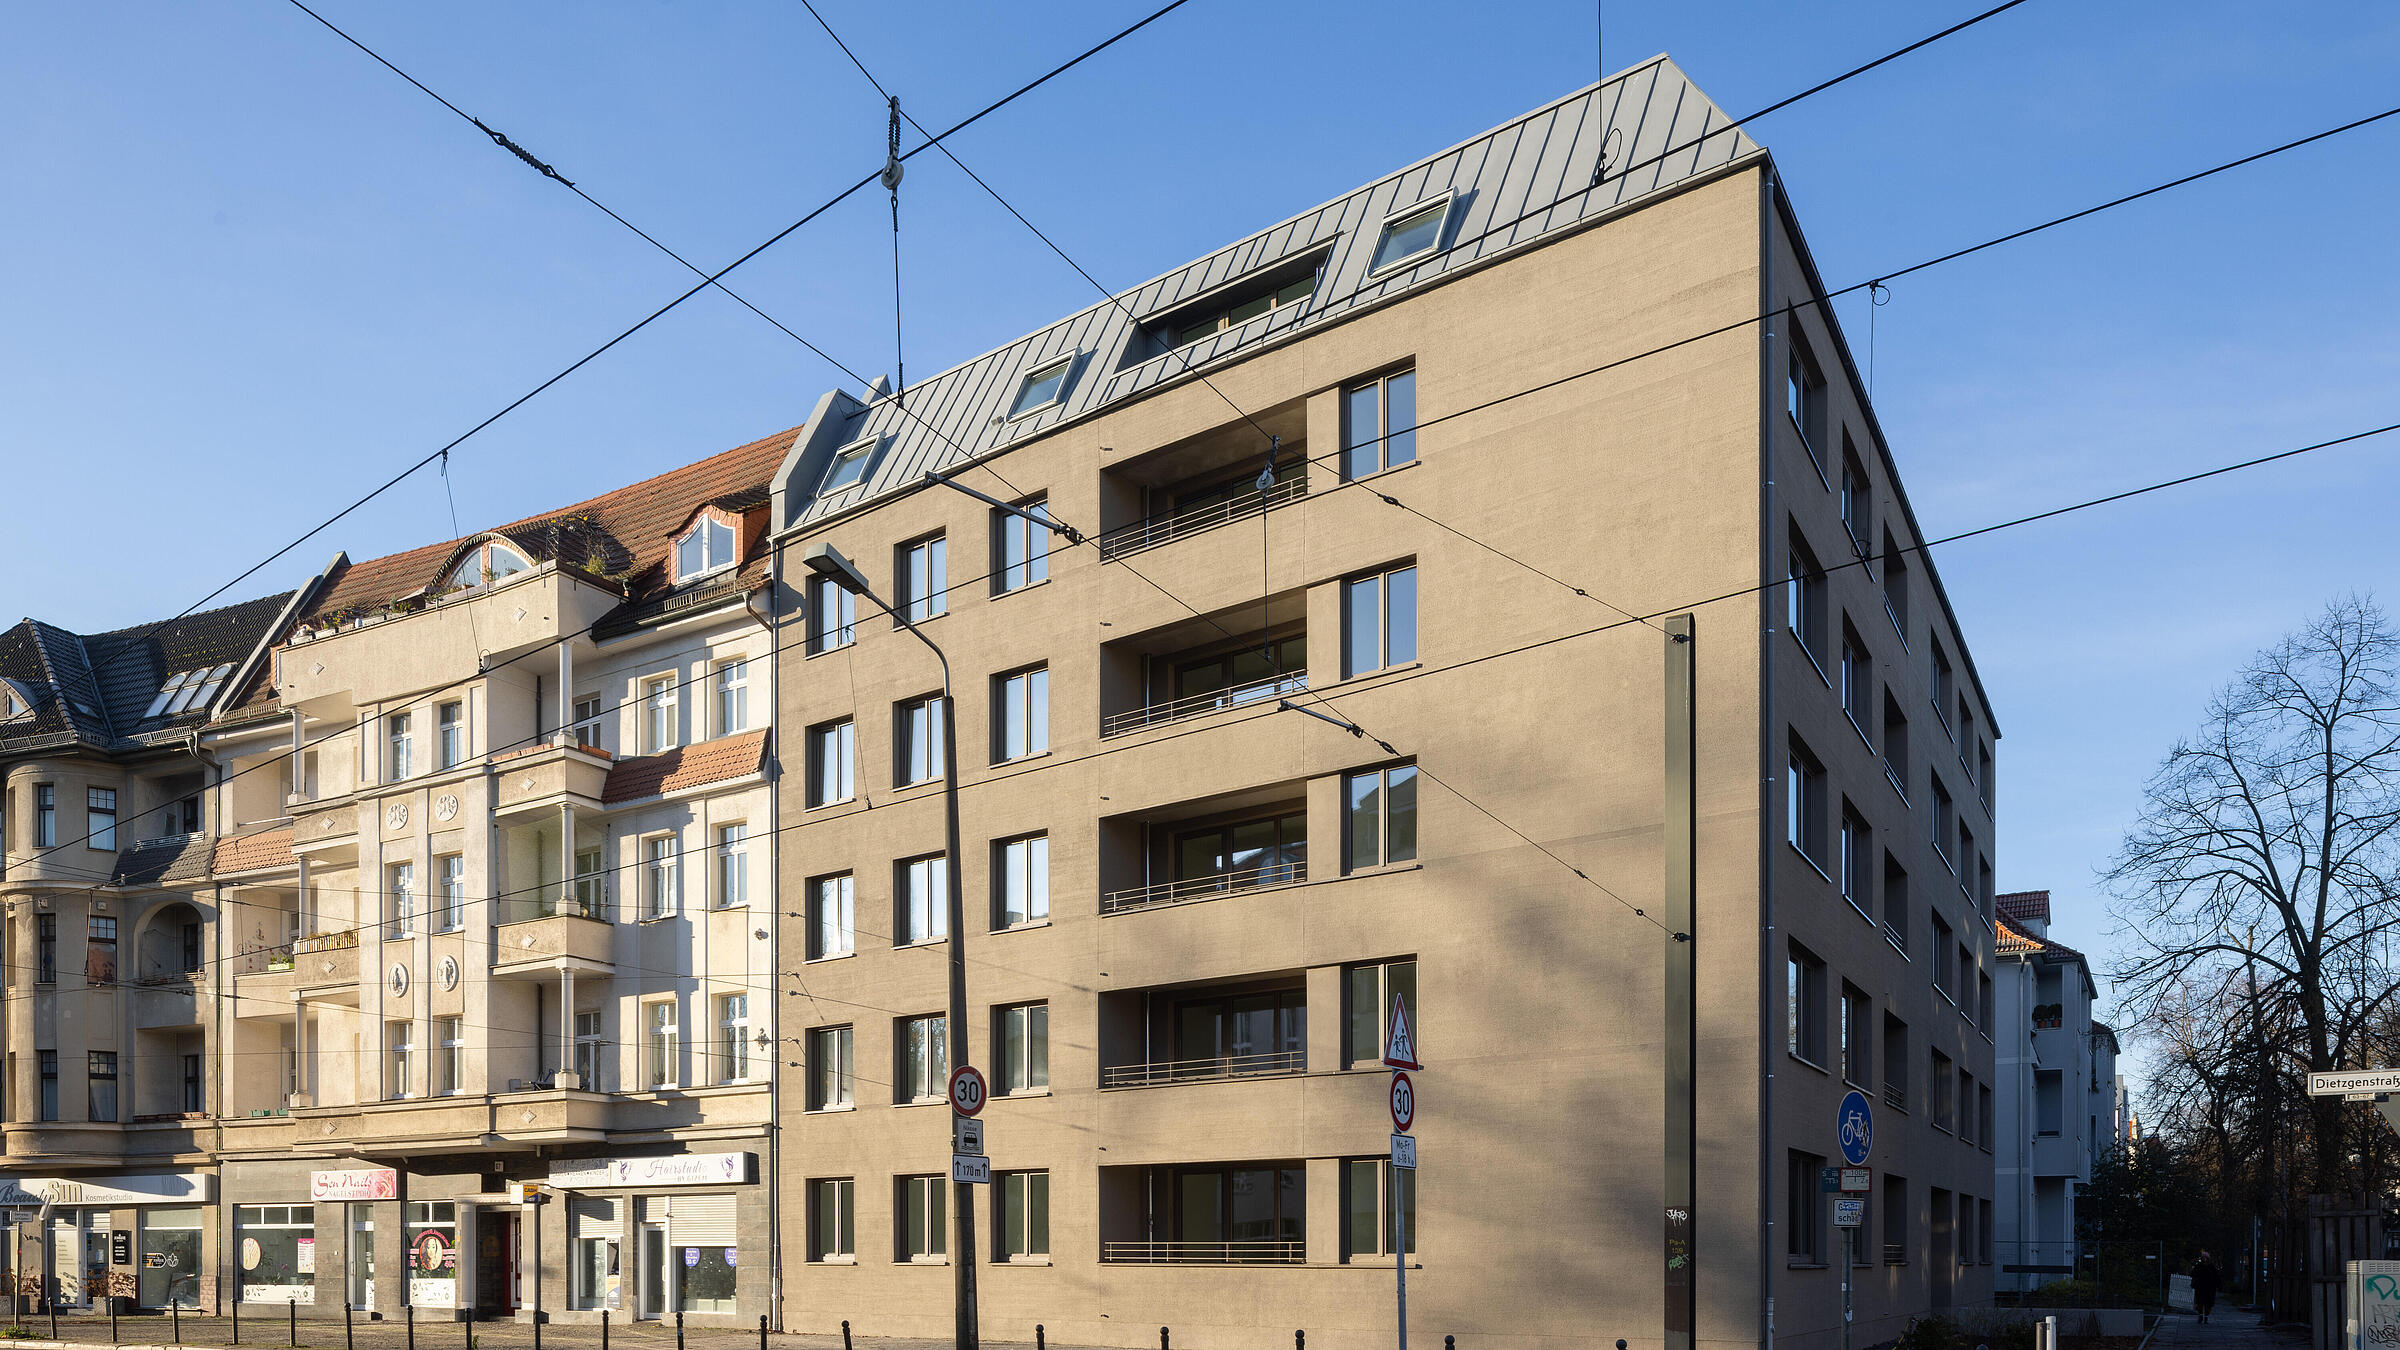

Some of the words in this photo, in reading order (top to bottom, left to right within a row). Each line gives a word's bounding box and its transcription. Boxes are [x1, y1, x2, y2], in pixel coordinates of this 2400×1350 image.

[957, 1080, 979, 1103] 30
[1395, 1088, 1410, 1116] 30
[962, 1164, 974, 1177] 170
[974, 1168, 981, 1177] m
[341, 1174, 372, 1188] Nails
[47, 1180, 83, 1204] Sun
[85, 1193, 133, 1202] Kosmetikstudio
